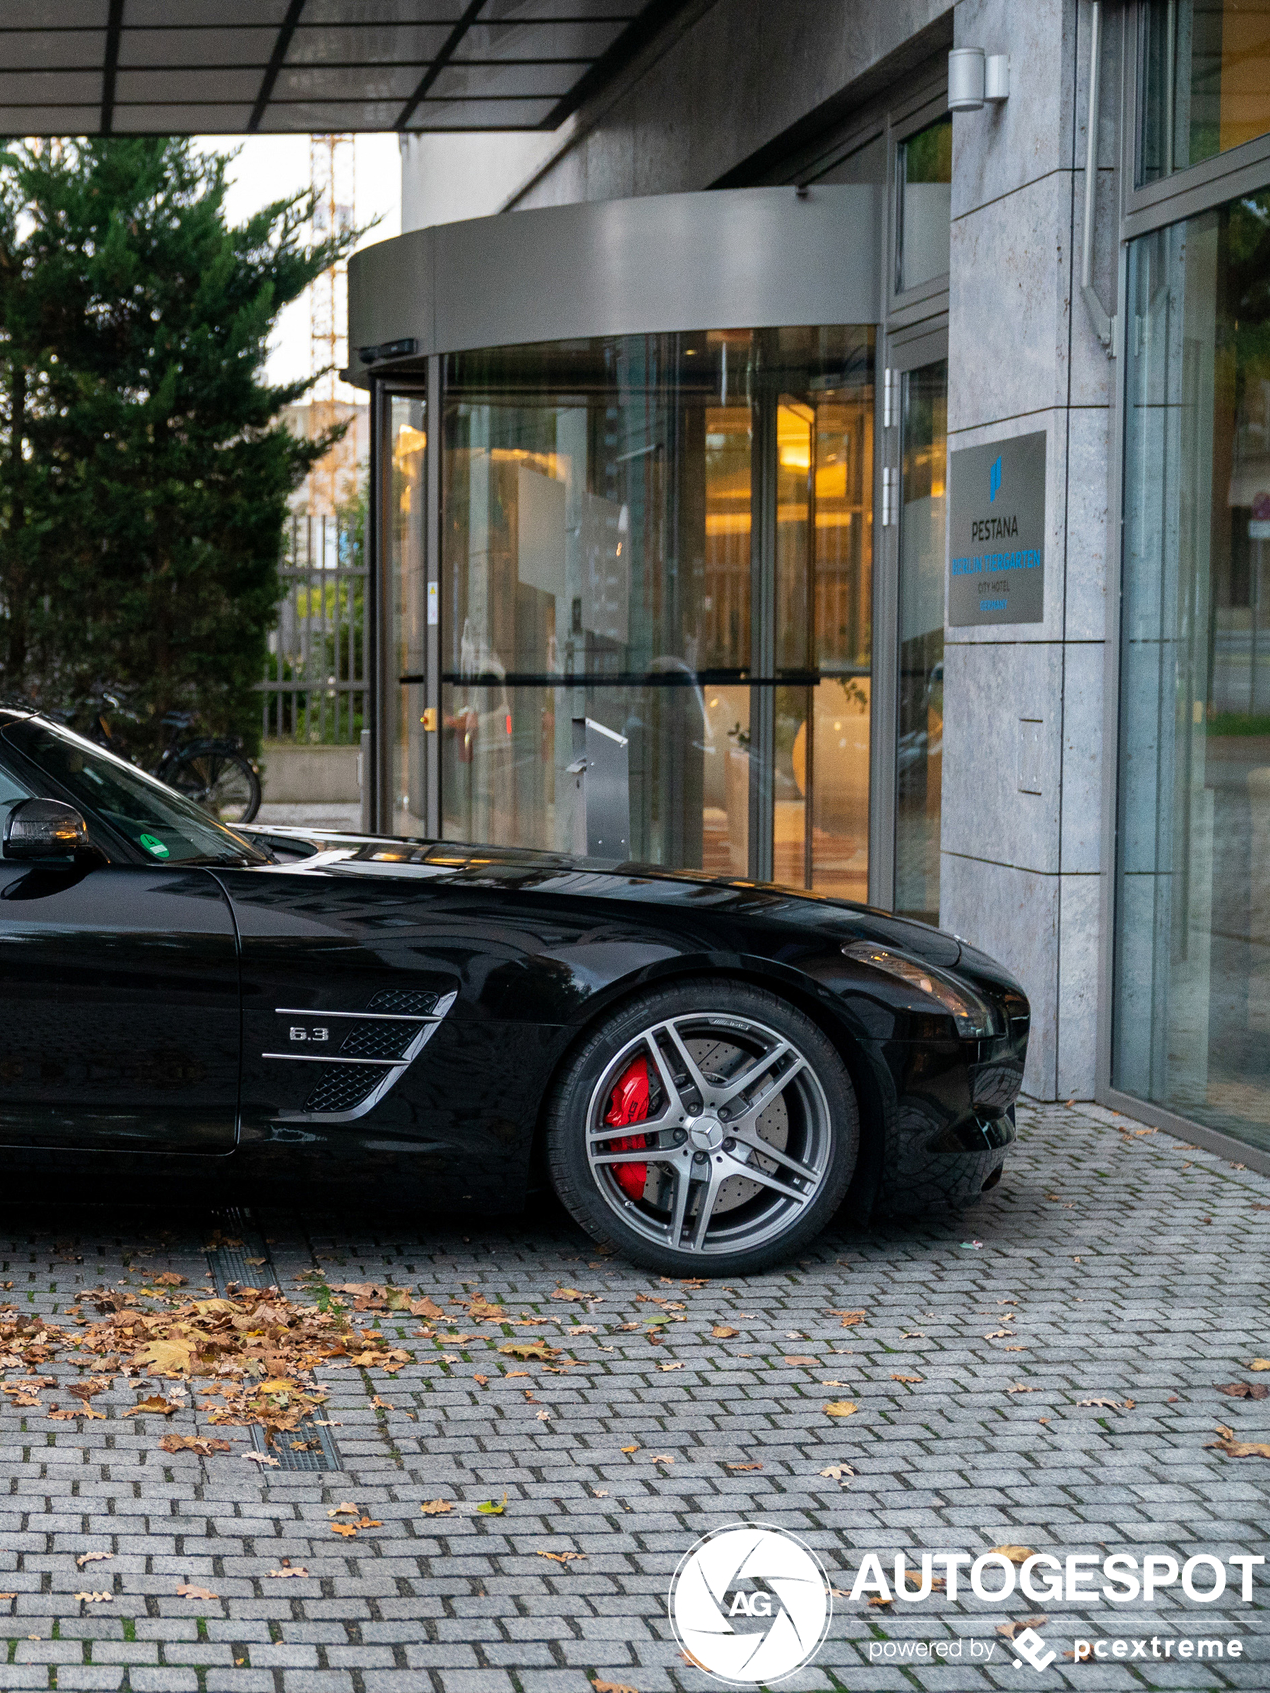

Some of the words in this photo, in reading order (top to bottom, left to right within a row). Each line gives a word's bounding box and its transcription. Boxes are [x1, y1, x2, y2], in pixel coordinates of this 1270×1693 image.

[971, 515, 1019, 542] PESTANA
[952, 556, 982, 576] BERLIN
[984, 549, 1040, 573] TIERGARTEN
[992, 580, 1010, 593] HOTEL
[980, 598, 1008, 612] GERMANY
[289, 1027, 329, 1041] 6.3
